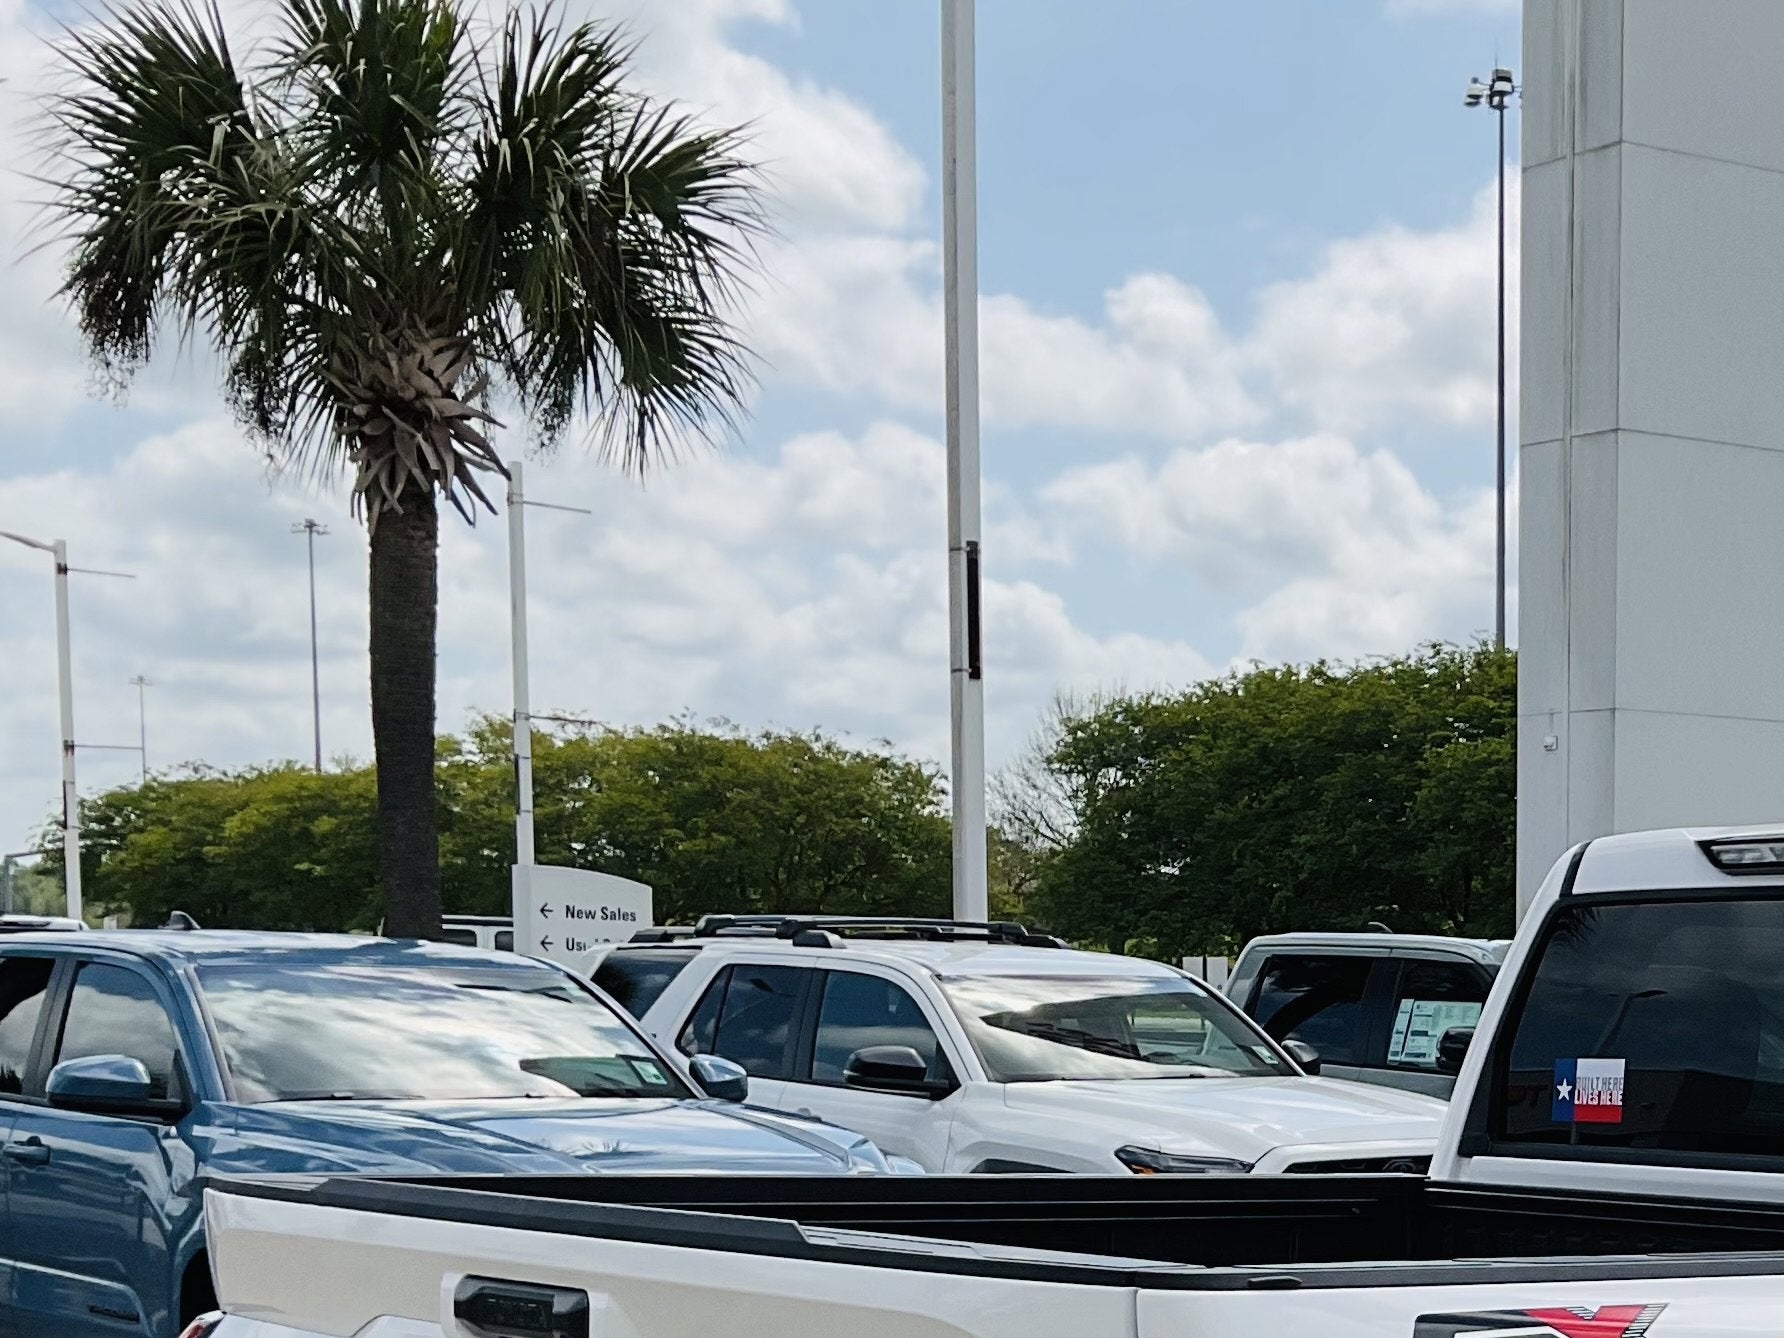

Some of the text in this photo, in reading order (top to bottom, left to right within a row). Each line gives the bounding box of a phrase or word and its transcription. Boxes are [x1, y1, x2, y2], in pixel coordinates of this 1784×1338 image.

[565, 904, 637, 922] New Sales
[1576, 1077, 1624, 1091] BUILT HERE
[1574, 1088, 1623, 1106] LIVES HERE
